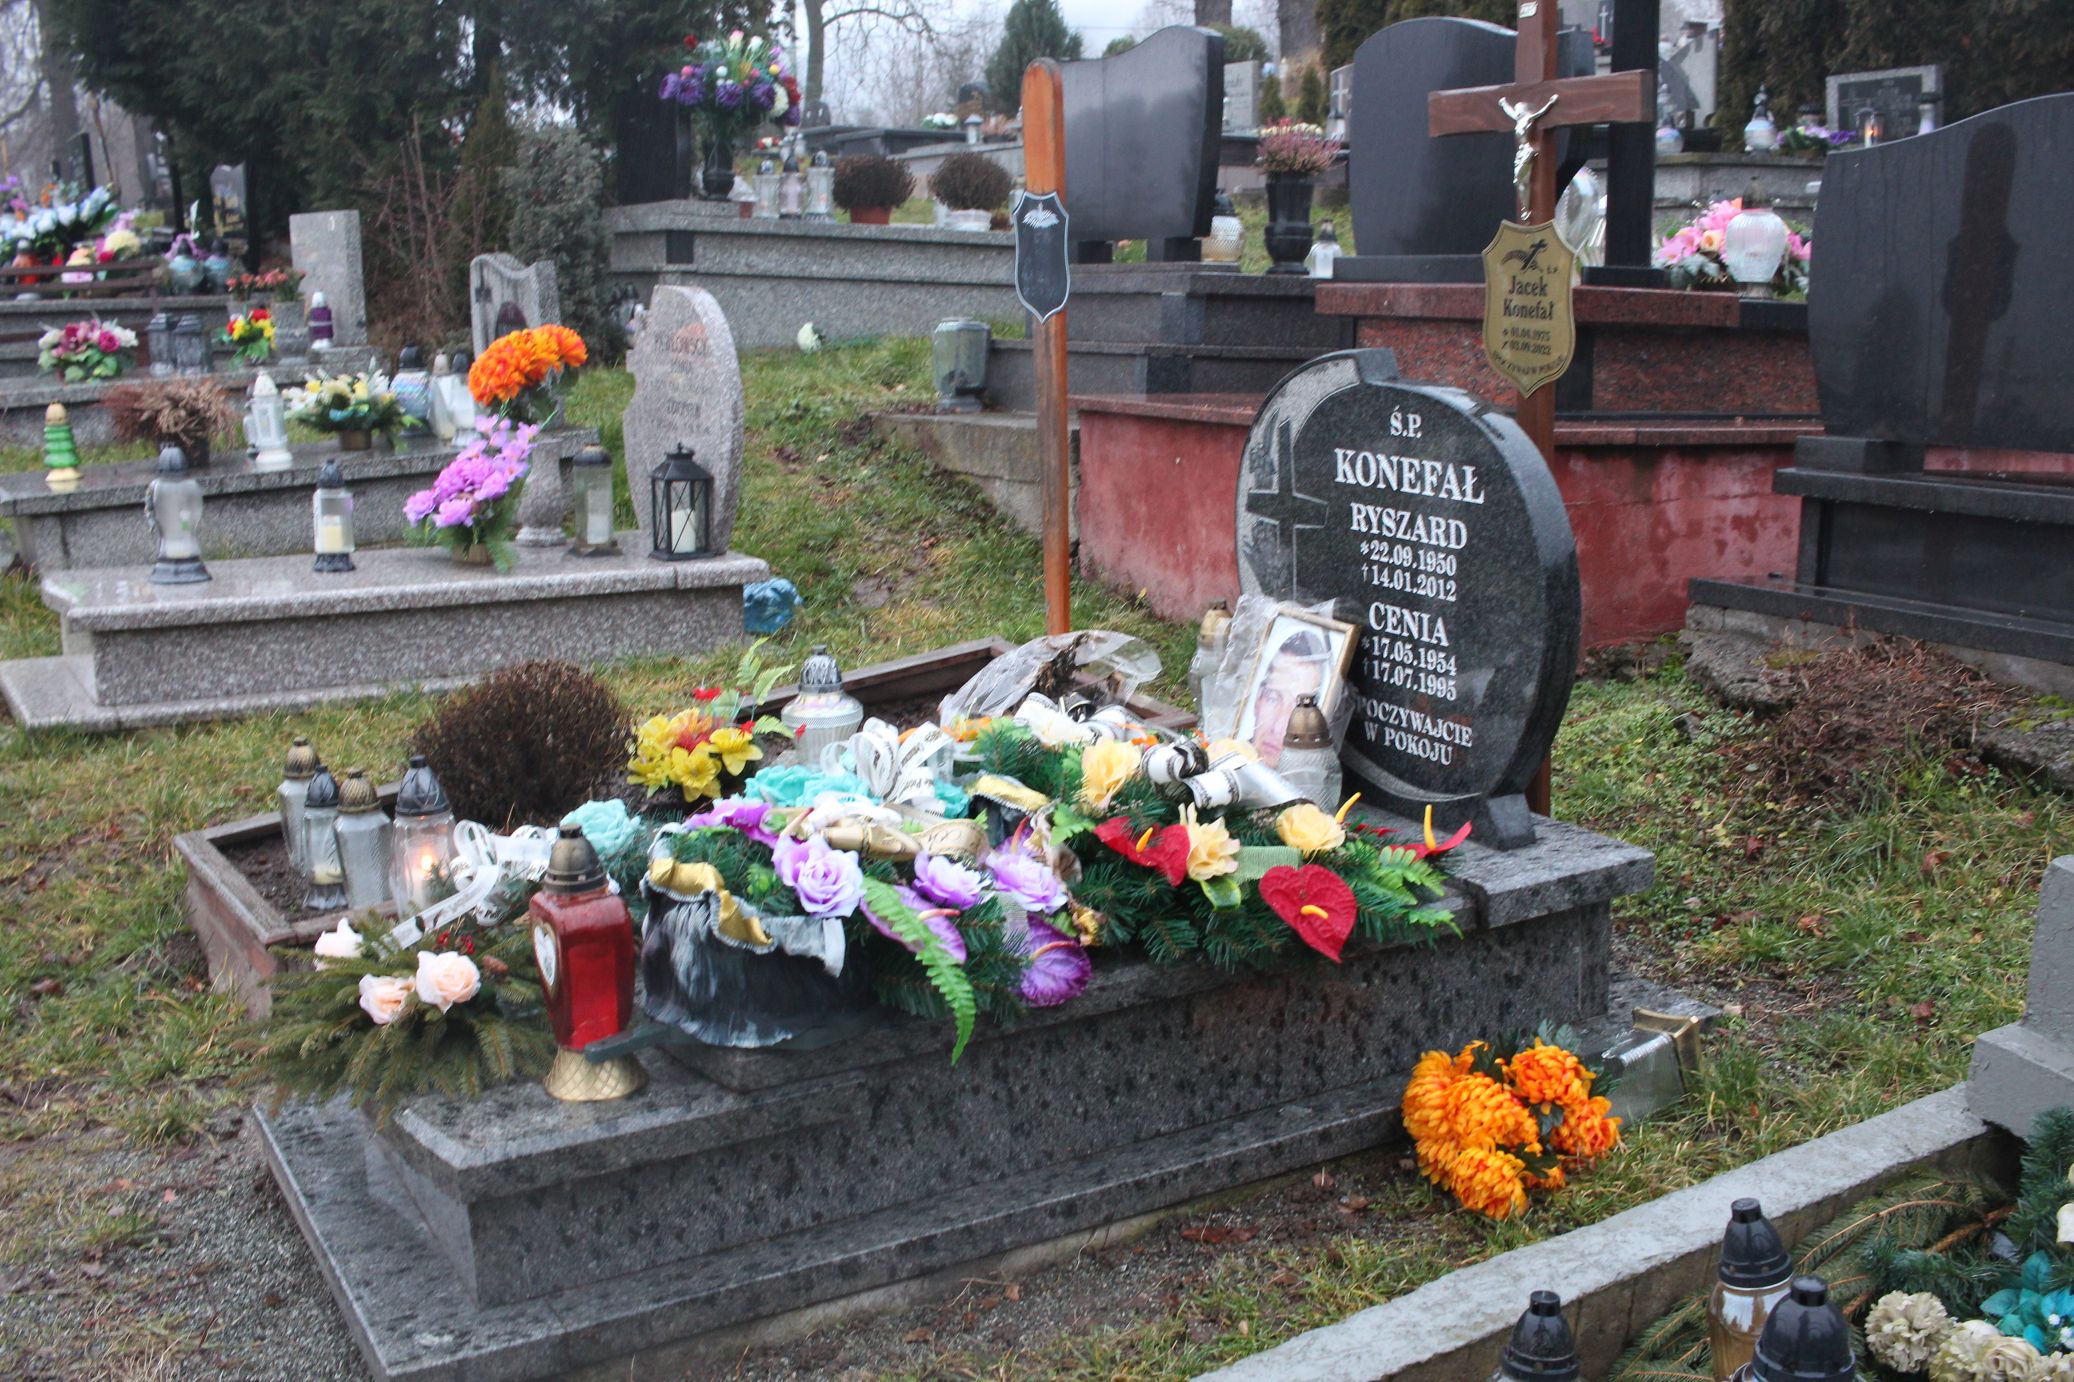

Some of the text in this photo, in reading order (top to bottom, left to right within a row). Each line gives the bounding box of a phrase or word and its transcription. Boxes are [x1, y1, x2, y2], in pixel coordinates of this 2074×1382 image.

[1509, 275, 1548, 297] Jacek
[1503, 298, 1555, 321] Konefał
[1390, 405, 1422, 439] Ś.P.
[1334, 447, 1485, 505] KONEFAŁ
[1350, 502, 1468, 550] RYSZARD
[1368, 602, 1450, 647] CENIA
[1356, 696, 1473, 748] POCZYWAJCIE
[1364, 721, 1453, 766] W POKOJU
